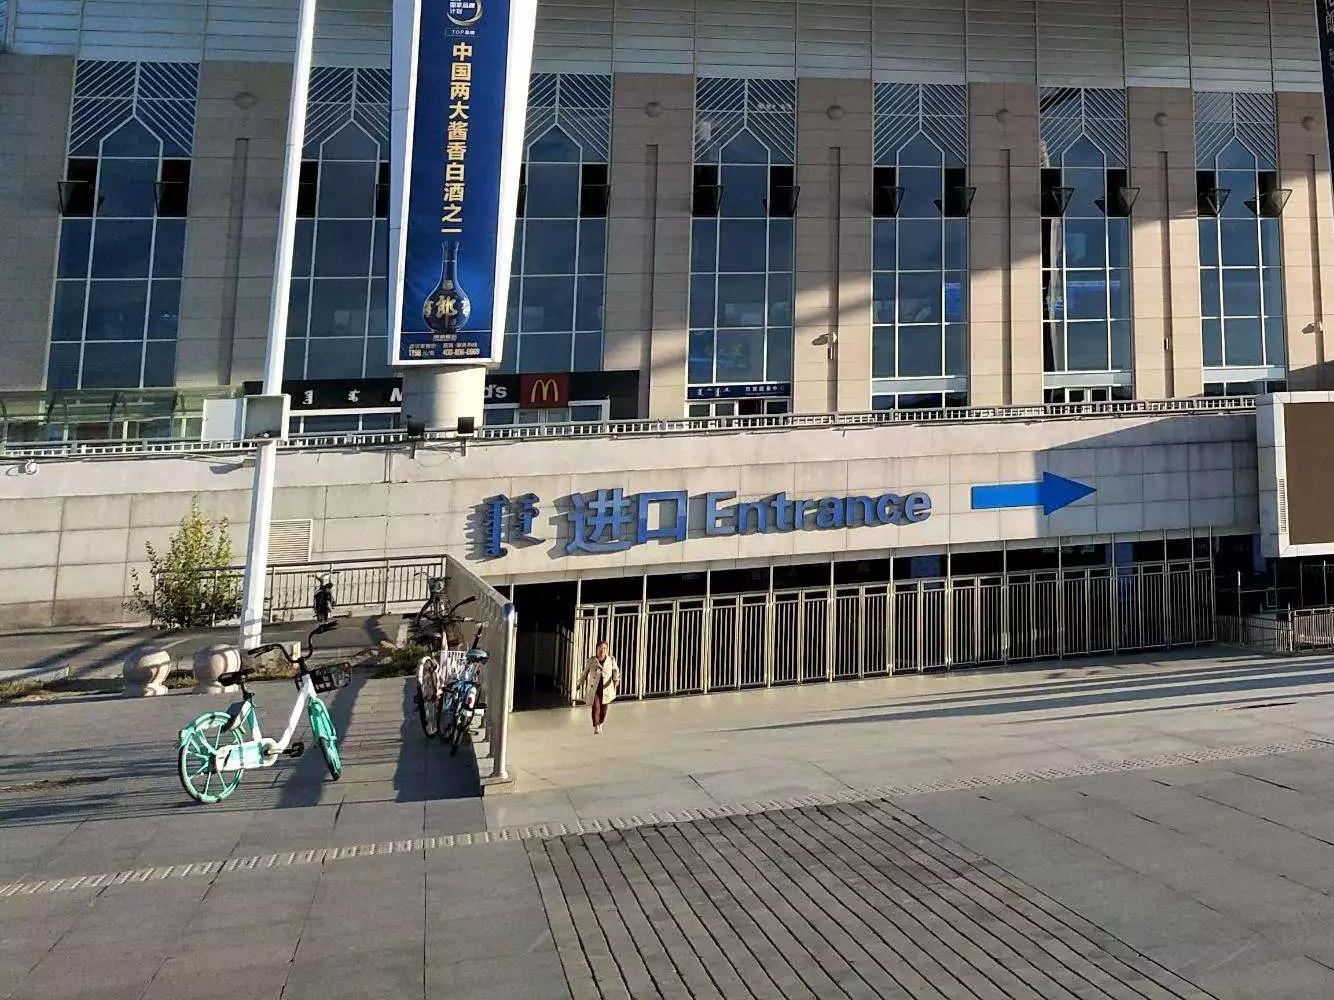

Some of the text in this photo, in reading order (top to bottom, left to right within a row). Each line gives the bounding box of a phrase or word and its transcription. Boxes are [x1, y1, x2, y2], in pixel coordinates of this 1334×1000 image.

[441, 42, 473, 233] 中国两大酱香白酒之一
[567, 488, 688, 555] 进口
[706, 490, 932, 536] Entrance
